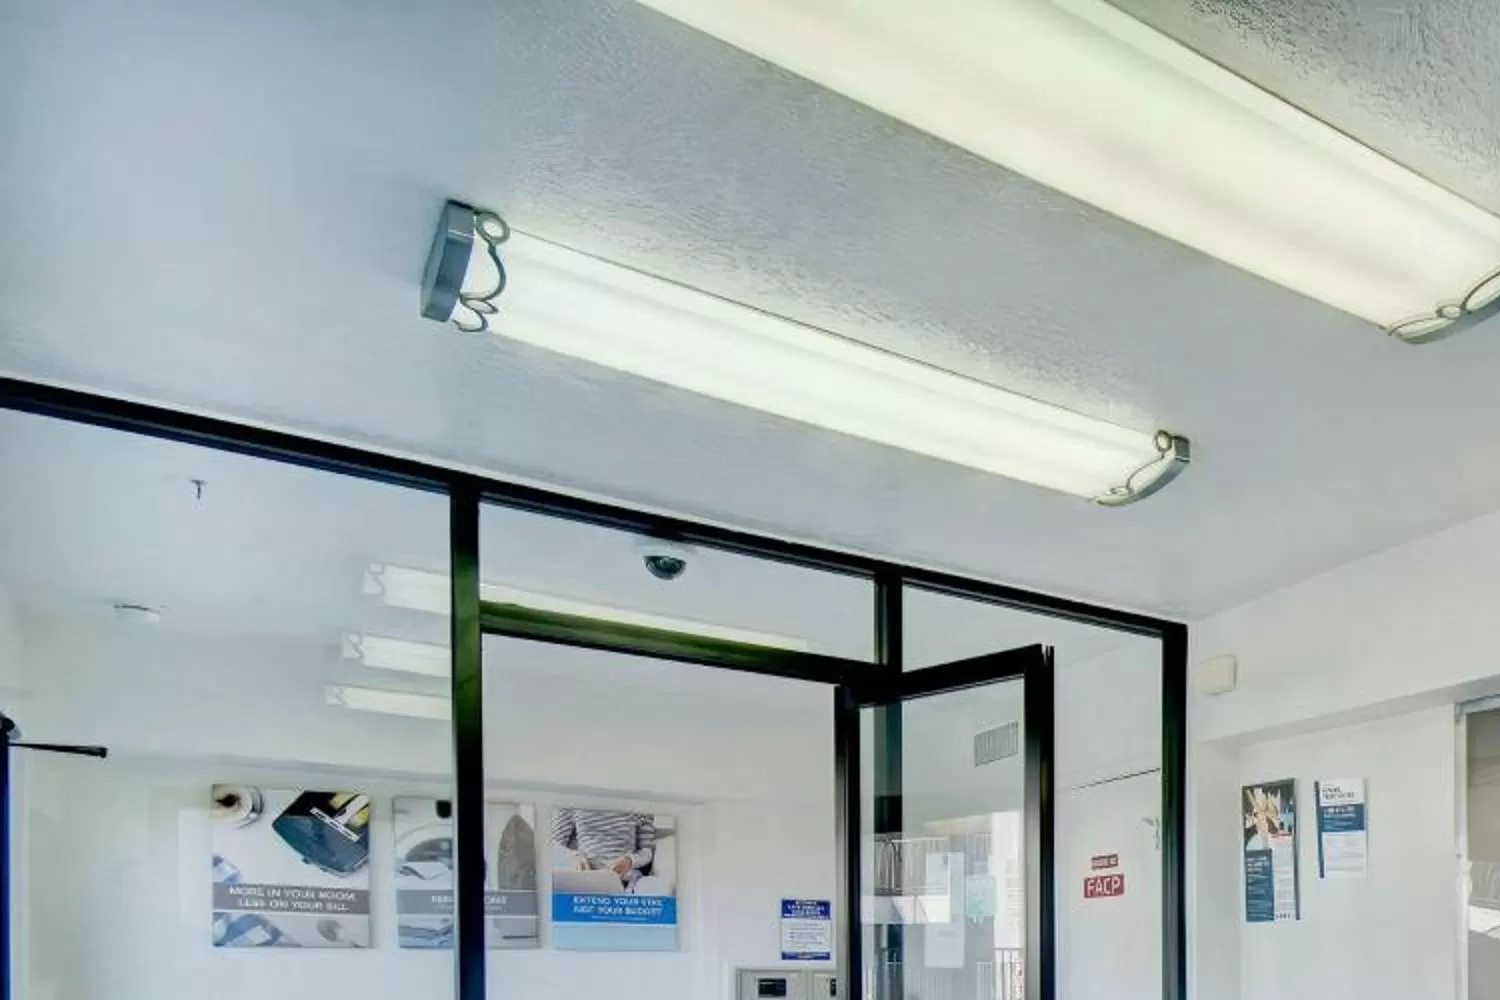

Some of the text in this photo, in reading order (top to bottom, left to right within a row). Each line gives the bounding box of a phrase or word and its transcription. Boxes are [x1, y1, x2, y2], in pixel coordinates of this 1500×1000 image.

[229, 887, 264, 896] MORE
[267, 888, 280, 897] IN
[284, 889, 315, 899] YOUR
[1087, 876, 1121, 897] FACP
